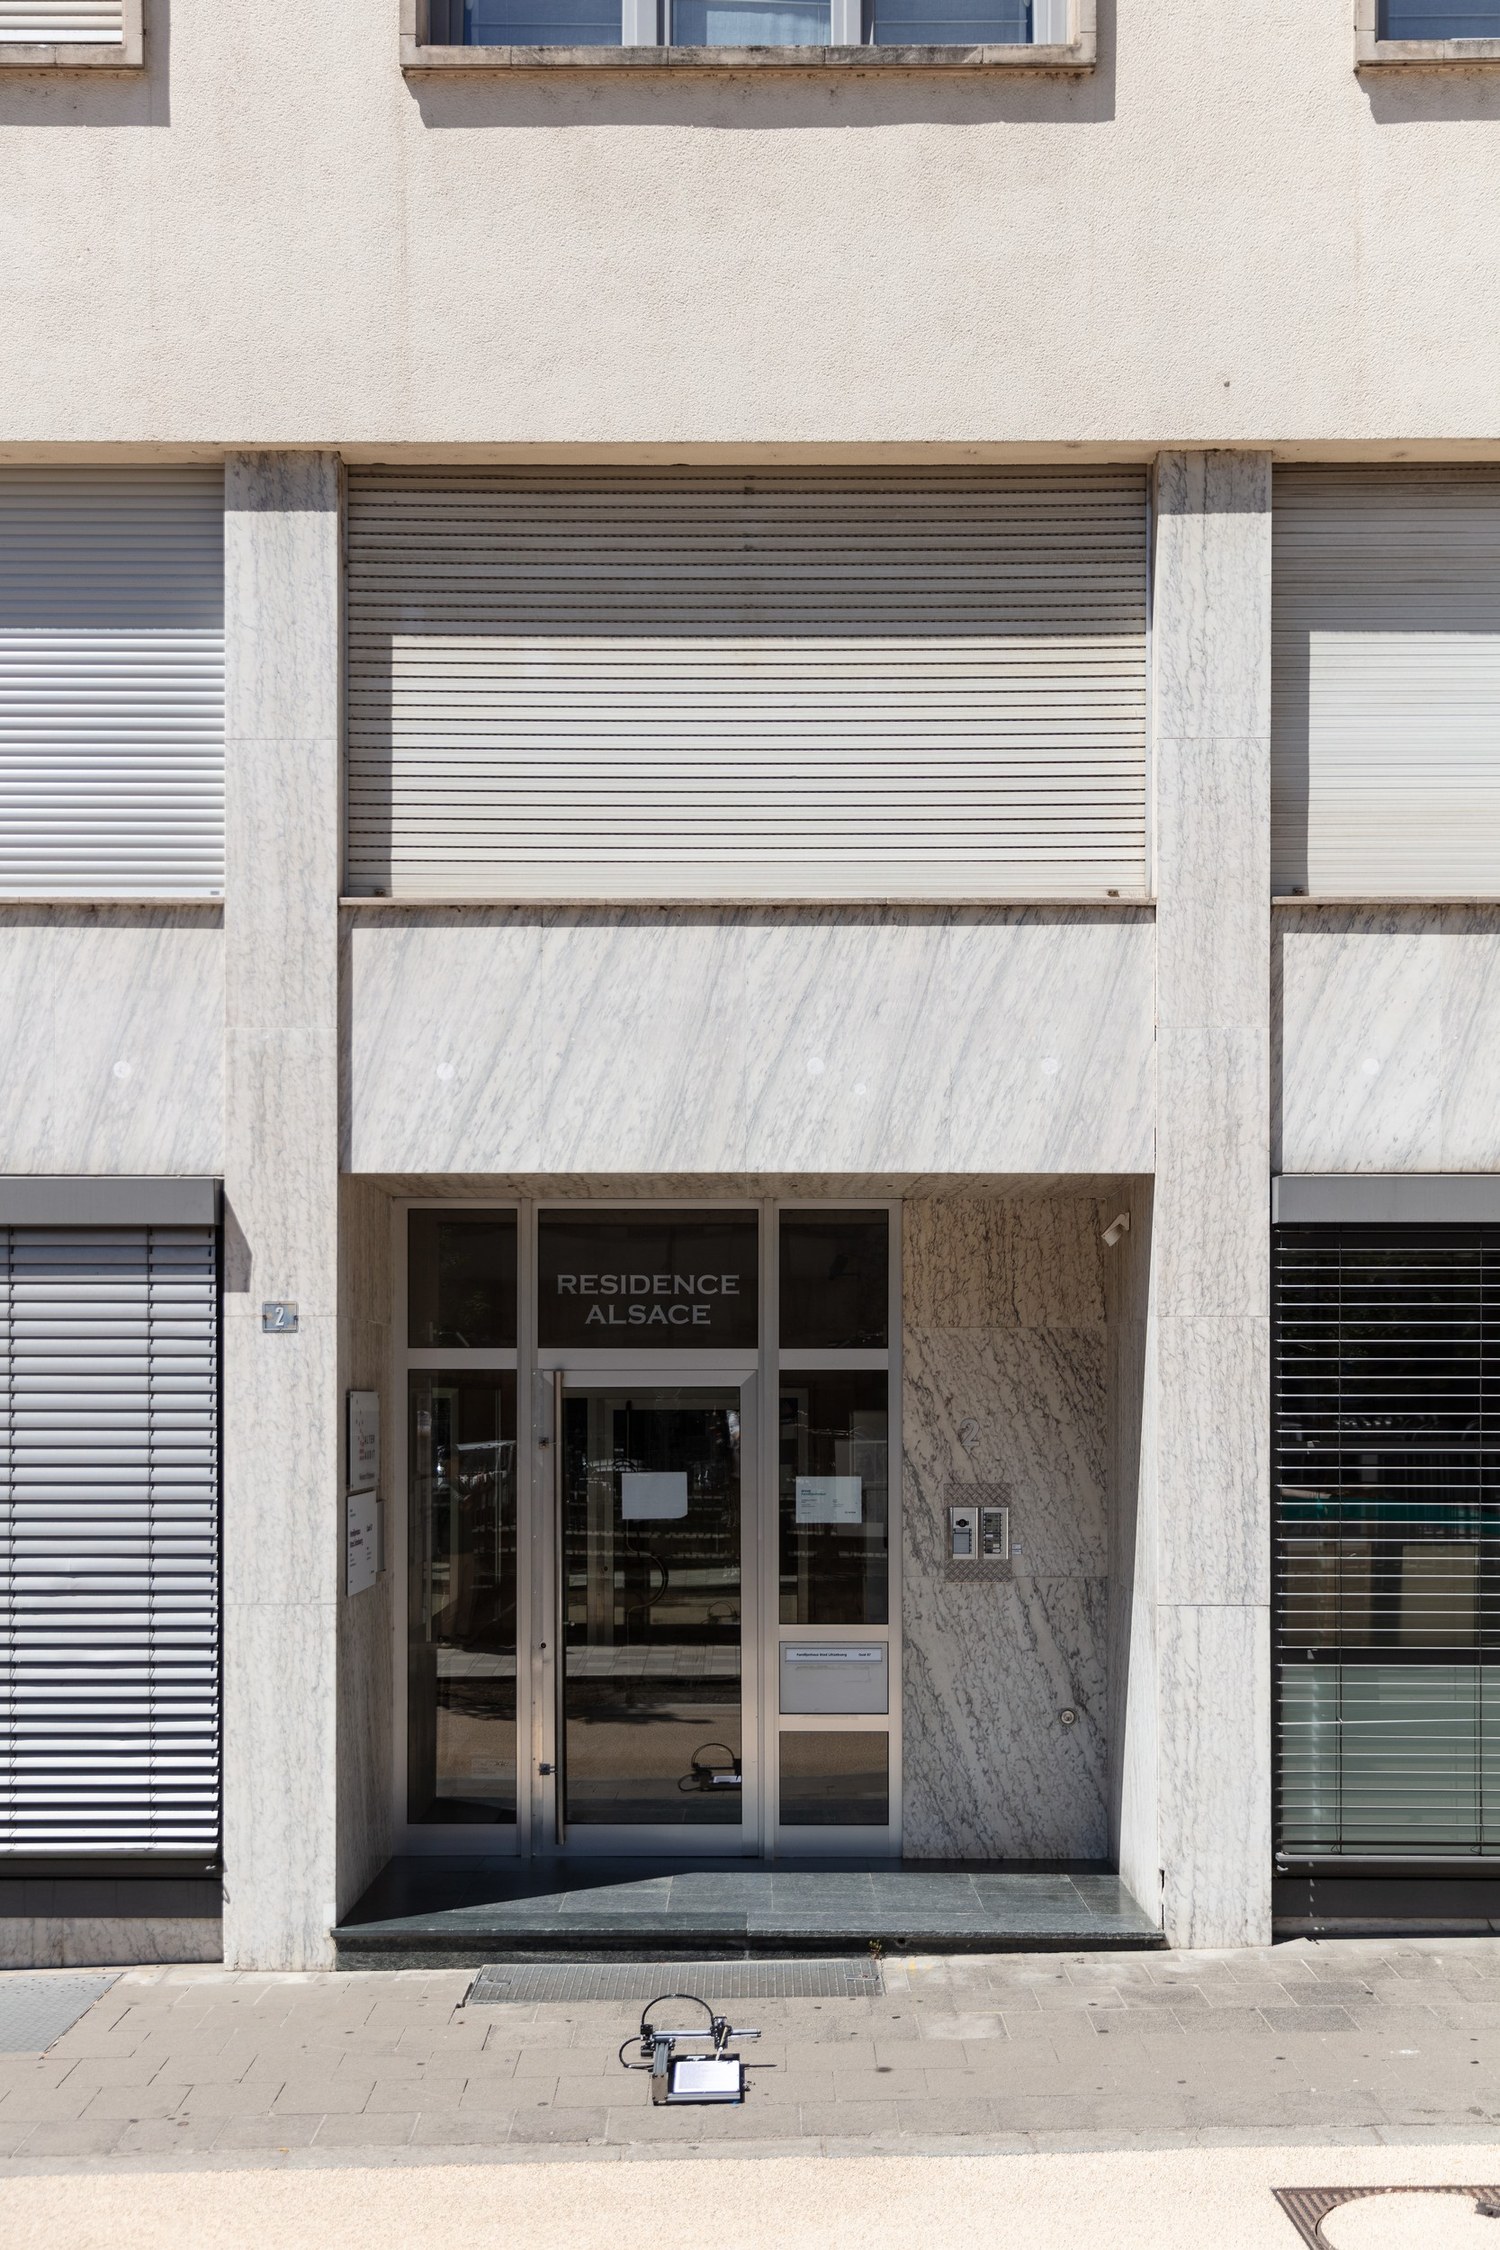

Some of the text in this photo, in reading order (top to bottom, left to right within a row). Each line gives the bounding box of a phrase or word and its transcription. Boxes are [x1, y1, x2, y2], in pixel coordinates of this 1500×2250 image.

[557, 1274, 740, 1295] RESIDENCE
[275, 1306, 285, 1326] 2
[584, 1304, 711, 1325] ALSACE
[960, 1417, 980, 1447] 2
